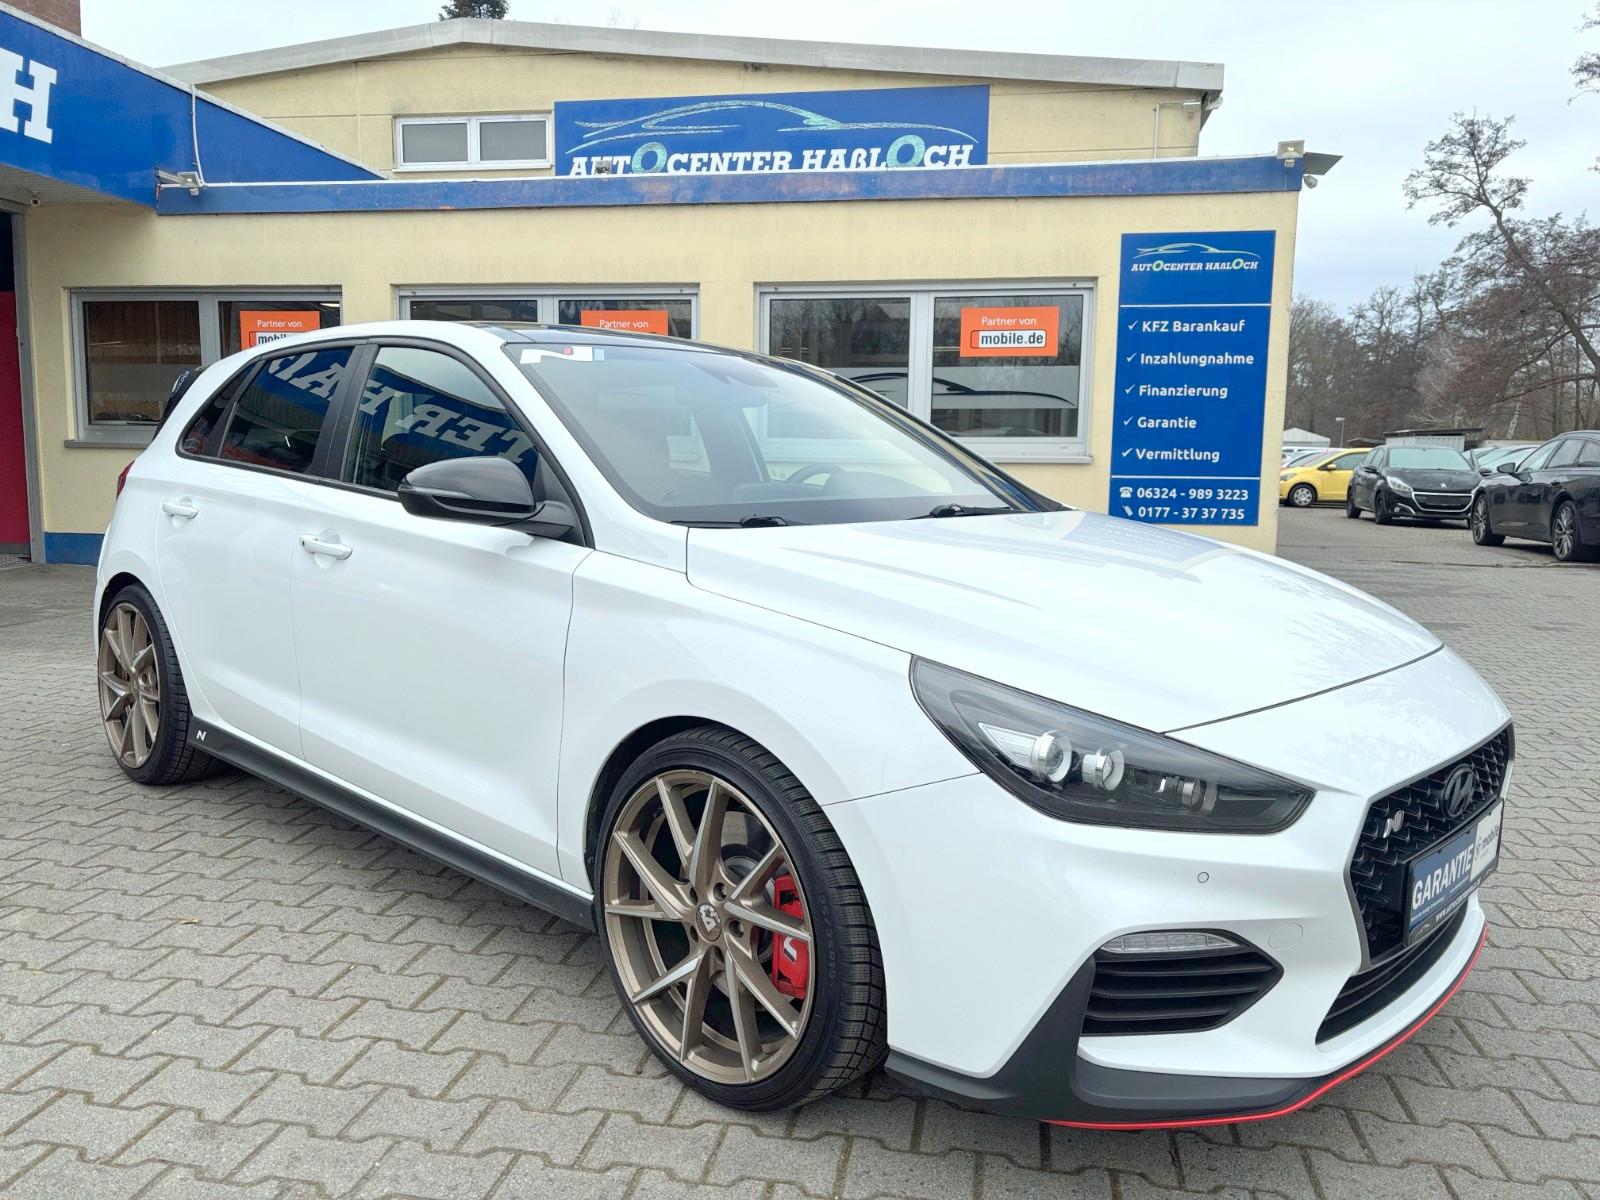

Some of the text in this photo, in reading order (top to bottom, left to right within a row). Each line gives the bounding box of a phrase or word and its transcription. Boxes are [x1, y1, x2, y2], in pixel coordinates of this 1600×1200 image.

[1131, 260, 1203, 272] AUTOCENTER
[257, 319, 303, 328] Partner von
[599, 319, 649, 329] Partner von
[981, 316, 1037, 326] Partner von
[1142, 320, 1246, 332] KFZ Barankauf
[981, 332, 1044, 345] mobile.de
[1140, 352, 1255, 367] Inzahlungnahme
[1138, 384, 1229, 399] Finanzierung
[1137, 416, 1197, 428] Garantie
[1136, 448, 1220, 463] Vermittlung
[1137, 487, 1177, 499] 06324
[1188, 488, 1213, 500] 989
[1216, 489, 1249, 500] 3223
[1138, 506, 1170, 518] 0177
[1182, 507, 1198, 518] 37
[1201, 507, 1217, 519] 37
[1221, 508, 1245, 519] 735
[196, 729, 207, 742] N
[1412, 843, 1475, 911] GARANTIE
